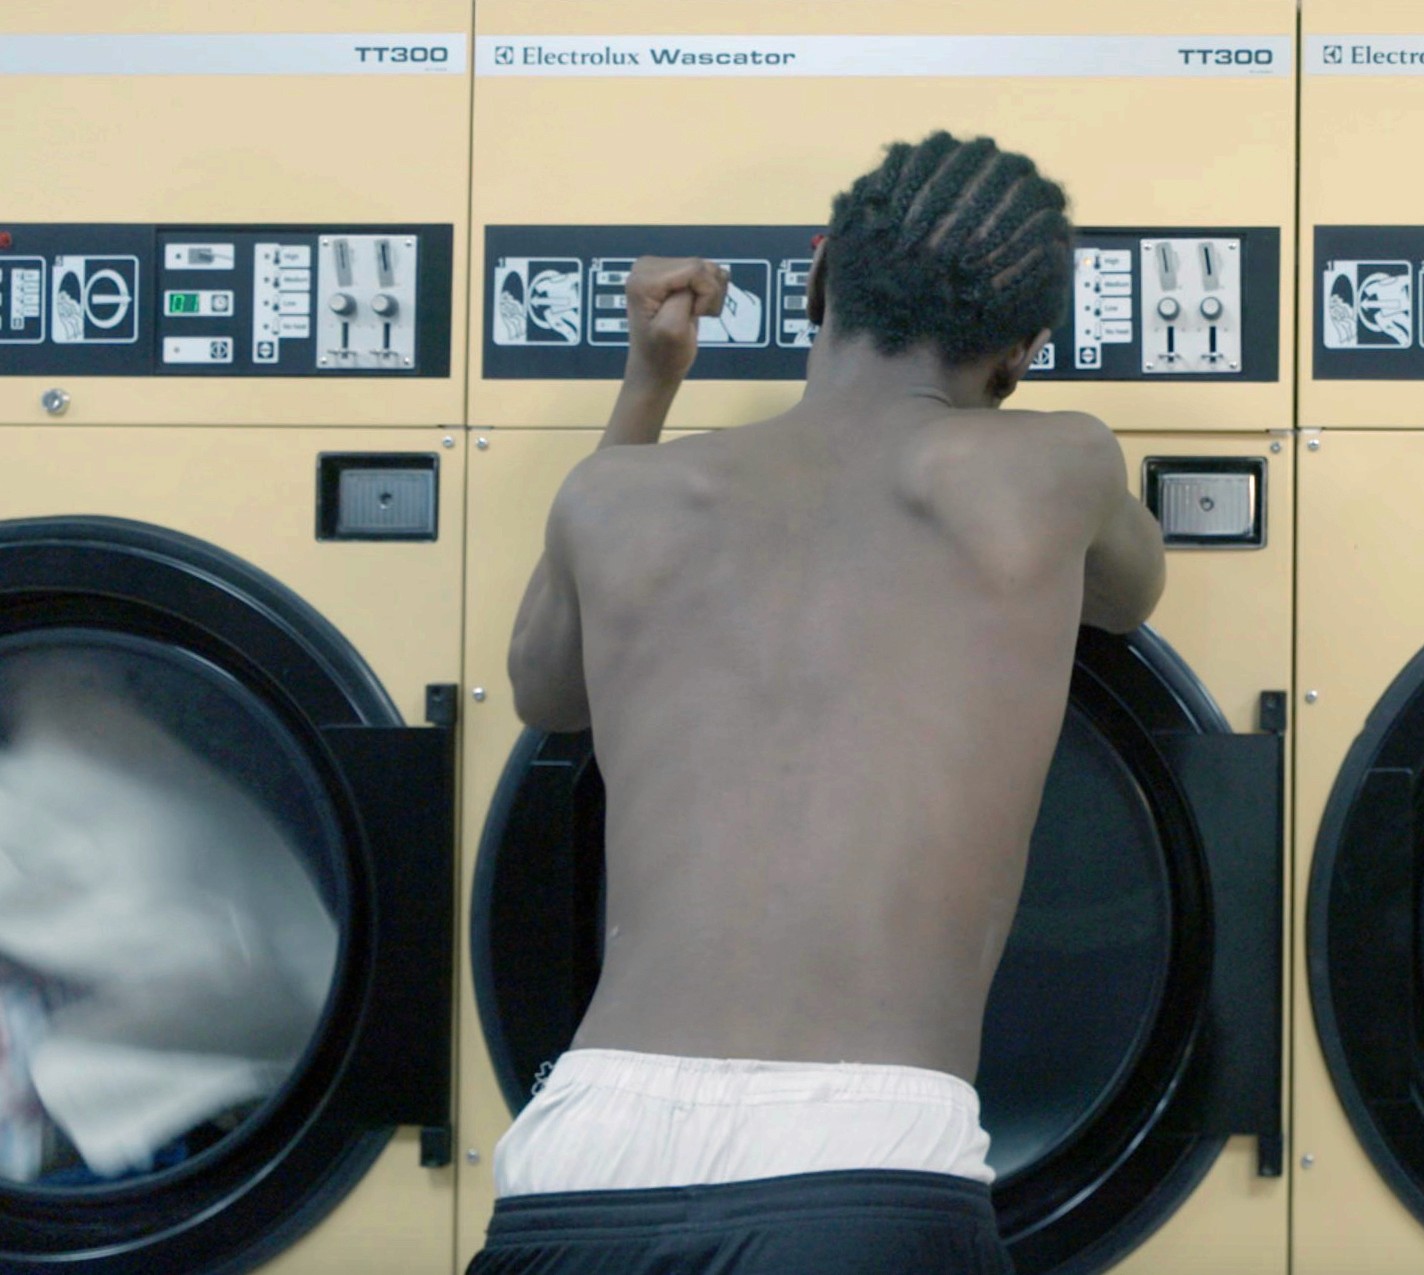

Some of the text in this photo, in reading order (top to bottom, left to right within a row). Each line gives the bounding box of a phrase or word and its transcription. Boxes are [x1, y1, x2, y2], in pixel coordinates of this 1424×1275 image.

[355, 47, 448, 62] TT300
[522, 46, 796, 65] Electrolux Wascator
[1178, 49, 1273, 65] TT300
